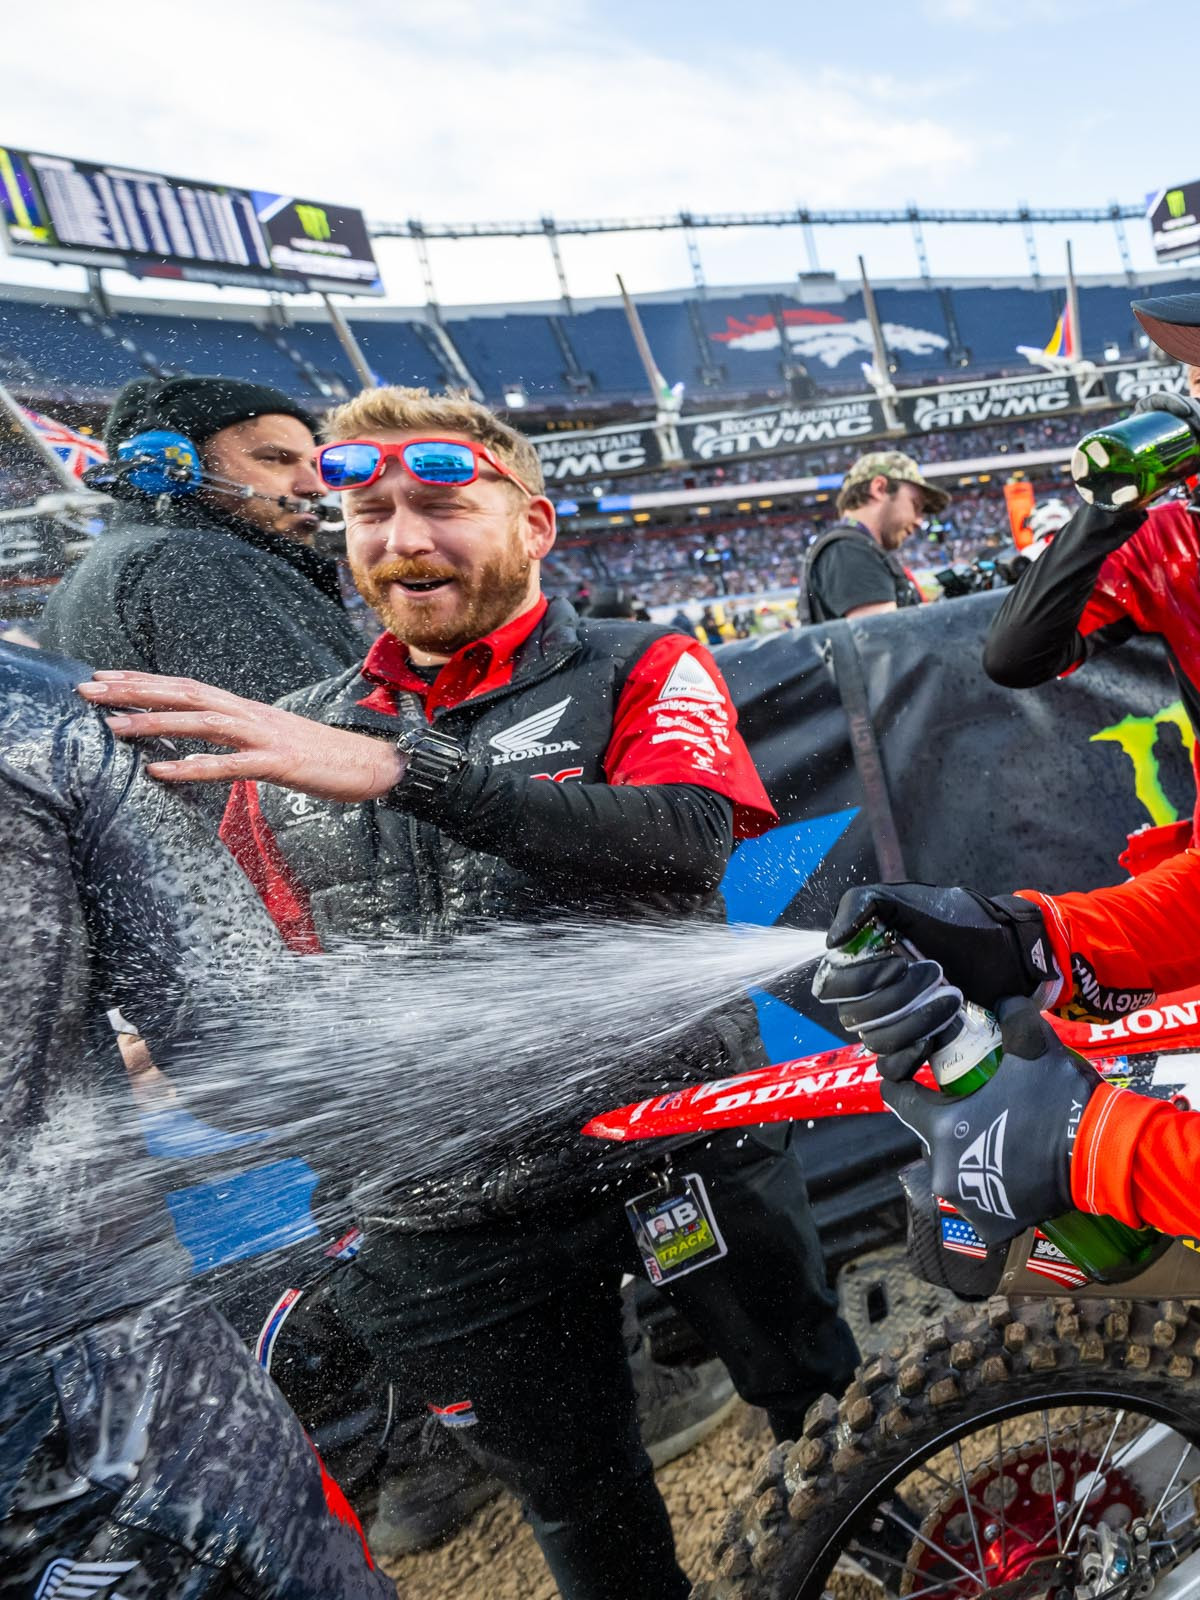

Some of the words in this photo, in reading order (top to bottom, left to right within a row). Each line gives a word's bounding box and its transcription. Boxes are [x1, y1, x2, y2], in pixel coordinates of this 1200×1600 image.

[937, 388, 987, 408] ROCKY
[988, 377, 1068, 401] MOUNTAIN
[720, 414, 778, 435] ROCKY
[778, 402, 871, 428] MOUNTAIN
[537, 432, 641, 461] MOUNTAIN
[491, 740, 581, 766] HONDA
[703, 1062, 883, 1116] DUNL
[1067, 1098, 1083, 1139] FLY
[659, 1230, 708, 1261] TRACK
